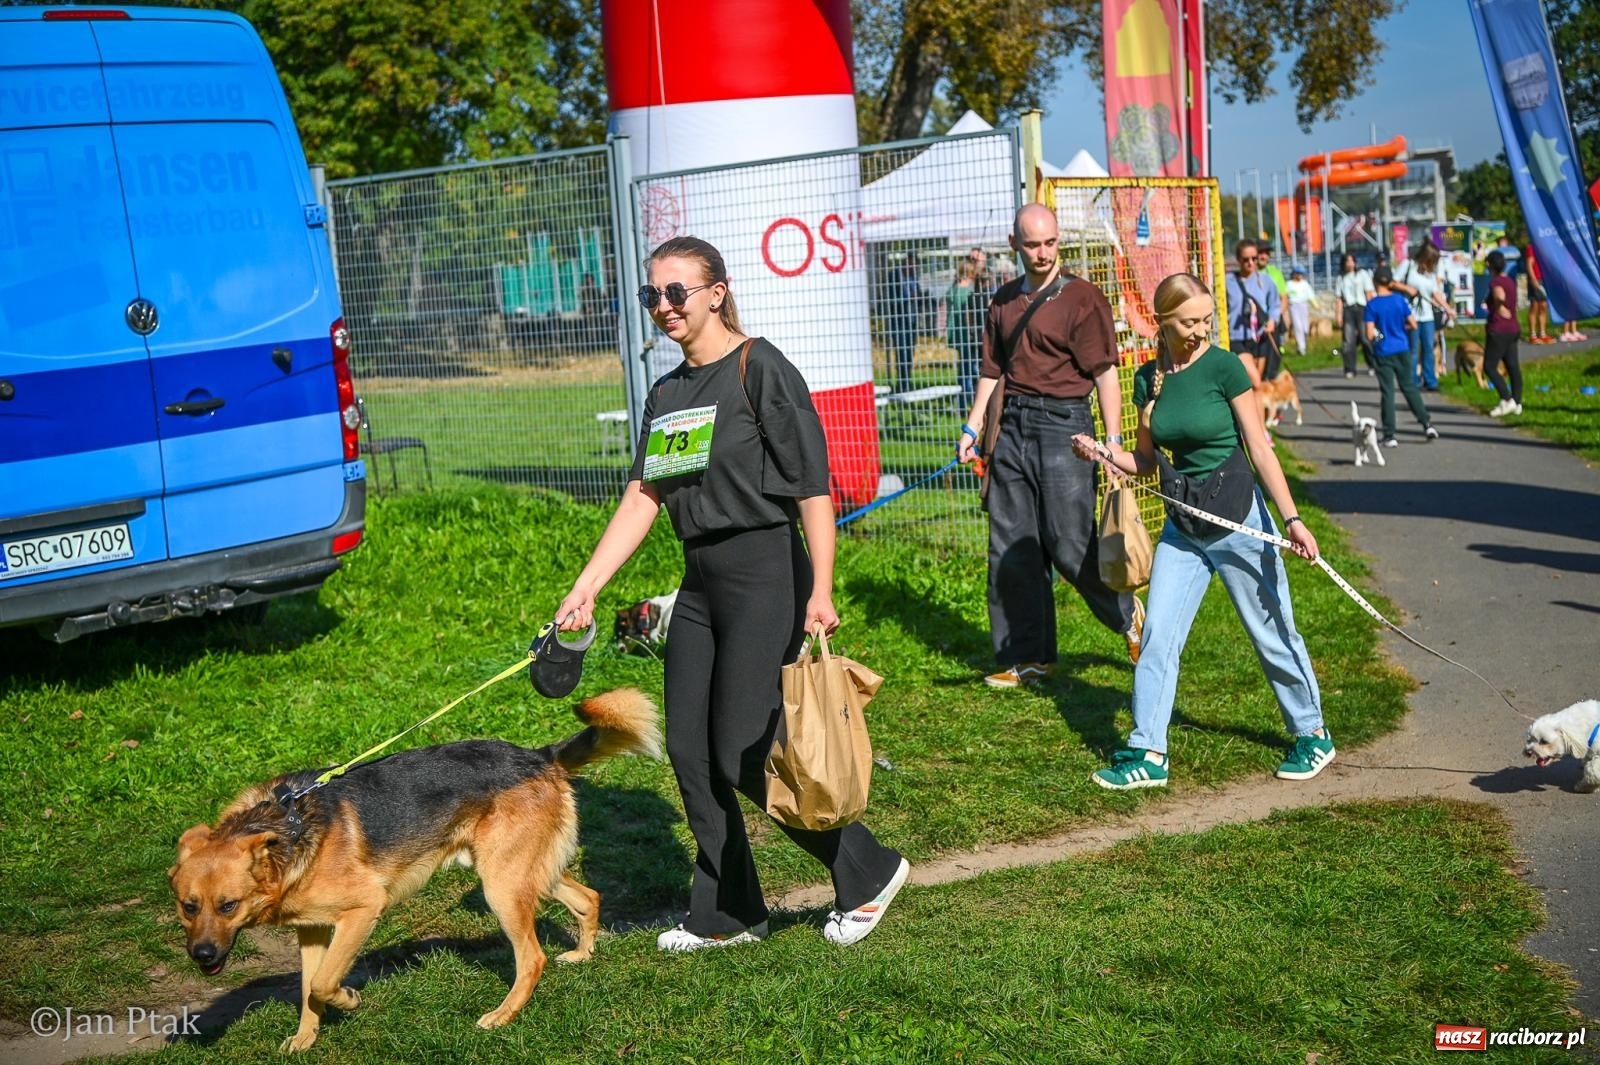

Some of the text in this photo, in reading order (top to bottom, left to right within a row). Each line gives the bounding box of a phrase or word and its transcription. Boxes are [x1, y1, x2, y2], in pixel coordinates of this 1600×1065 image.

[71, 144, 260, 200] Jansen
[76, 205, 266, 242] Fensterbau
[664, 430, 689, 454] 73
[7, 528, 126, 568] SRC 07609
